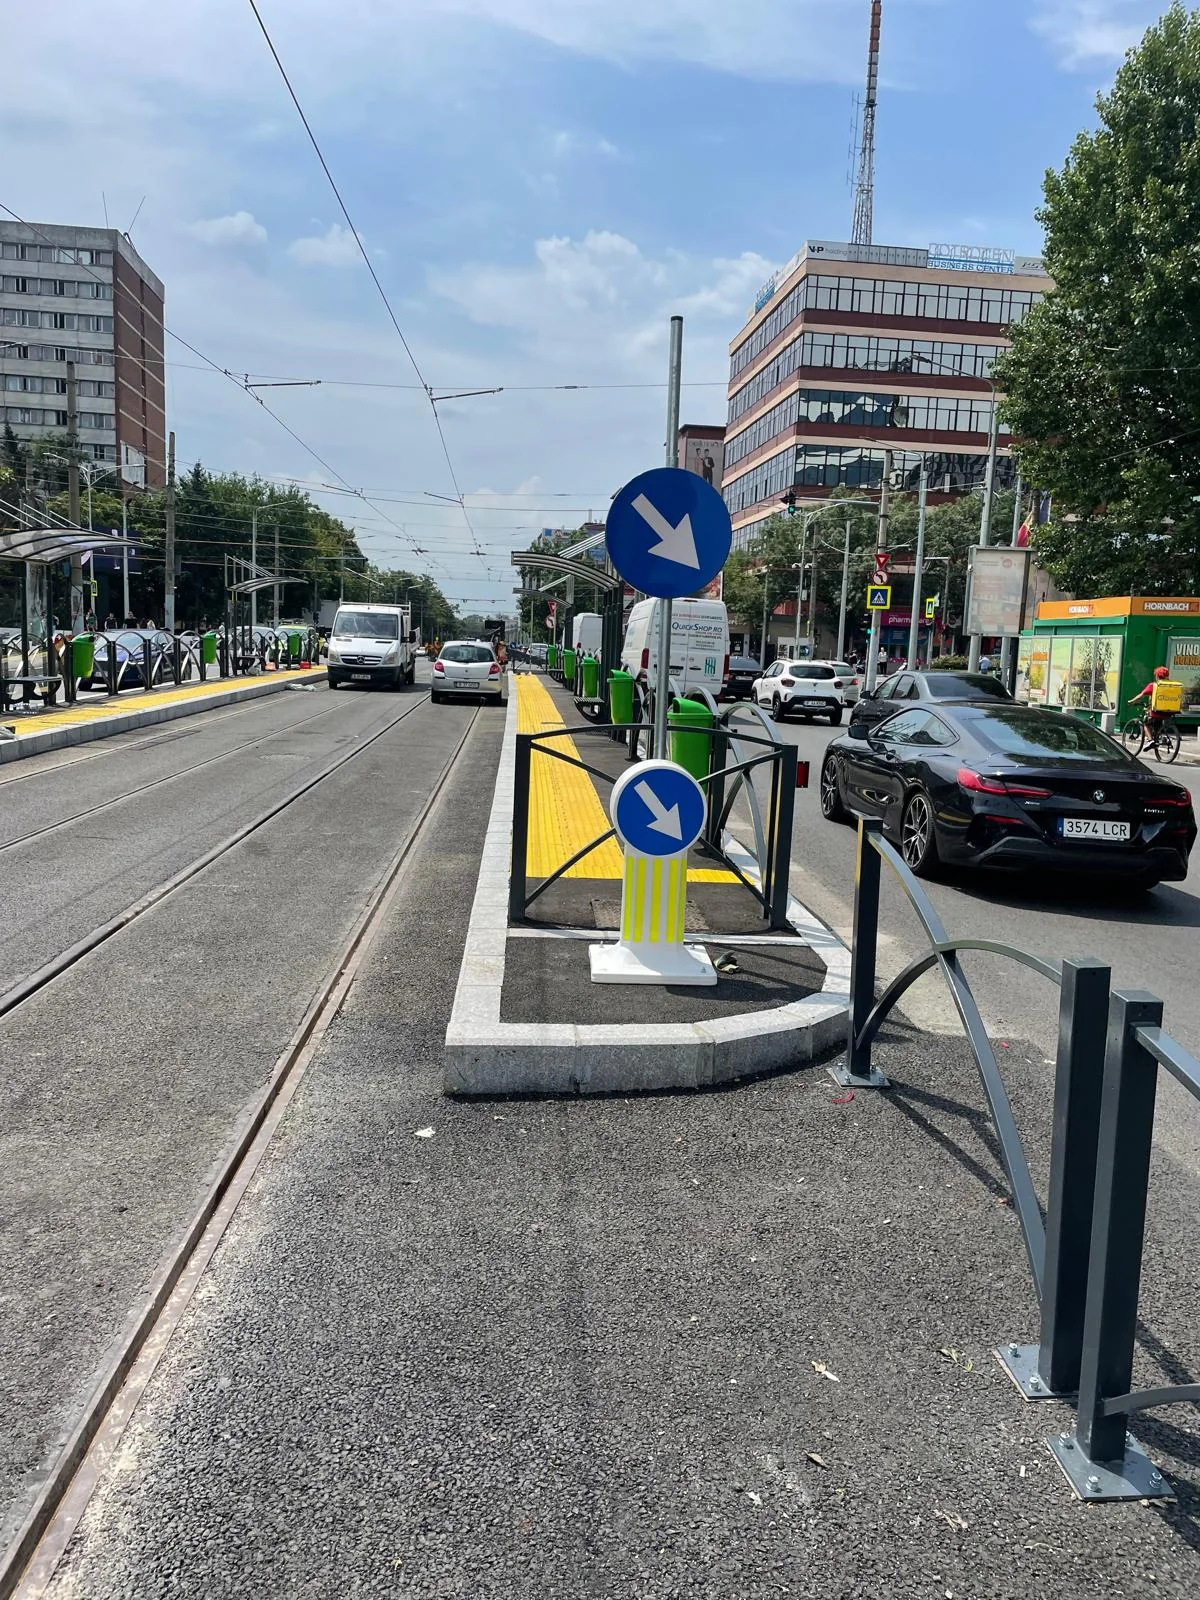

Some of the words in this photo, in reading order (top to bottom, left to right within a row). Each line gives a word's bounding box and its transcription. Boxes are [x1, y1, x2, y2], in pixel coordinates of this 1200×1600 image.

[928, 260, 974, 270] BUSINESS
[976, 264, 1014, 274] CENTER
[1144, 602, 1189, 611] HORNBACH
[888, 615, 930, 624] pharmare
[1176, 643, 1200, 655] VINO
[1066, 821, 1099, 834] 3574
[1103, 823, 1127, 837] LCR
